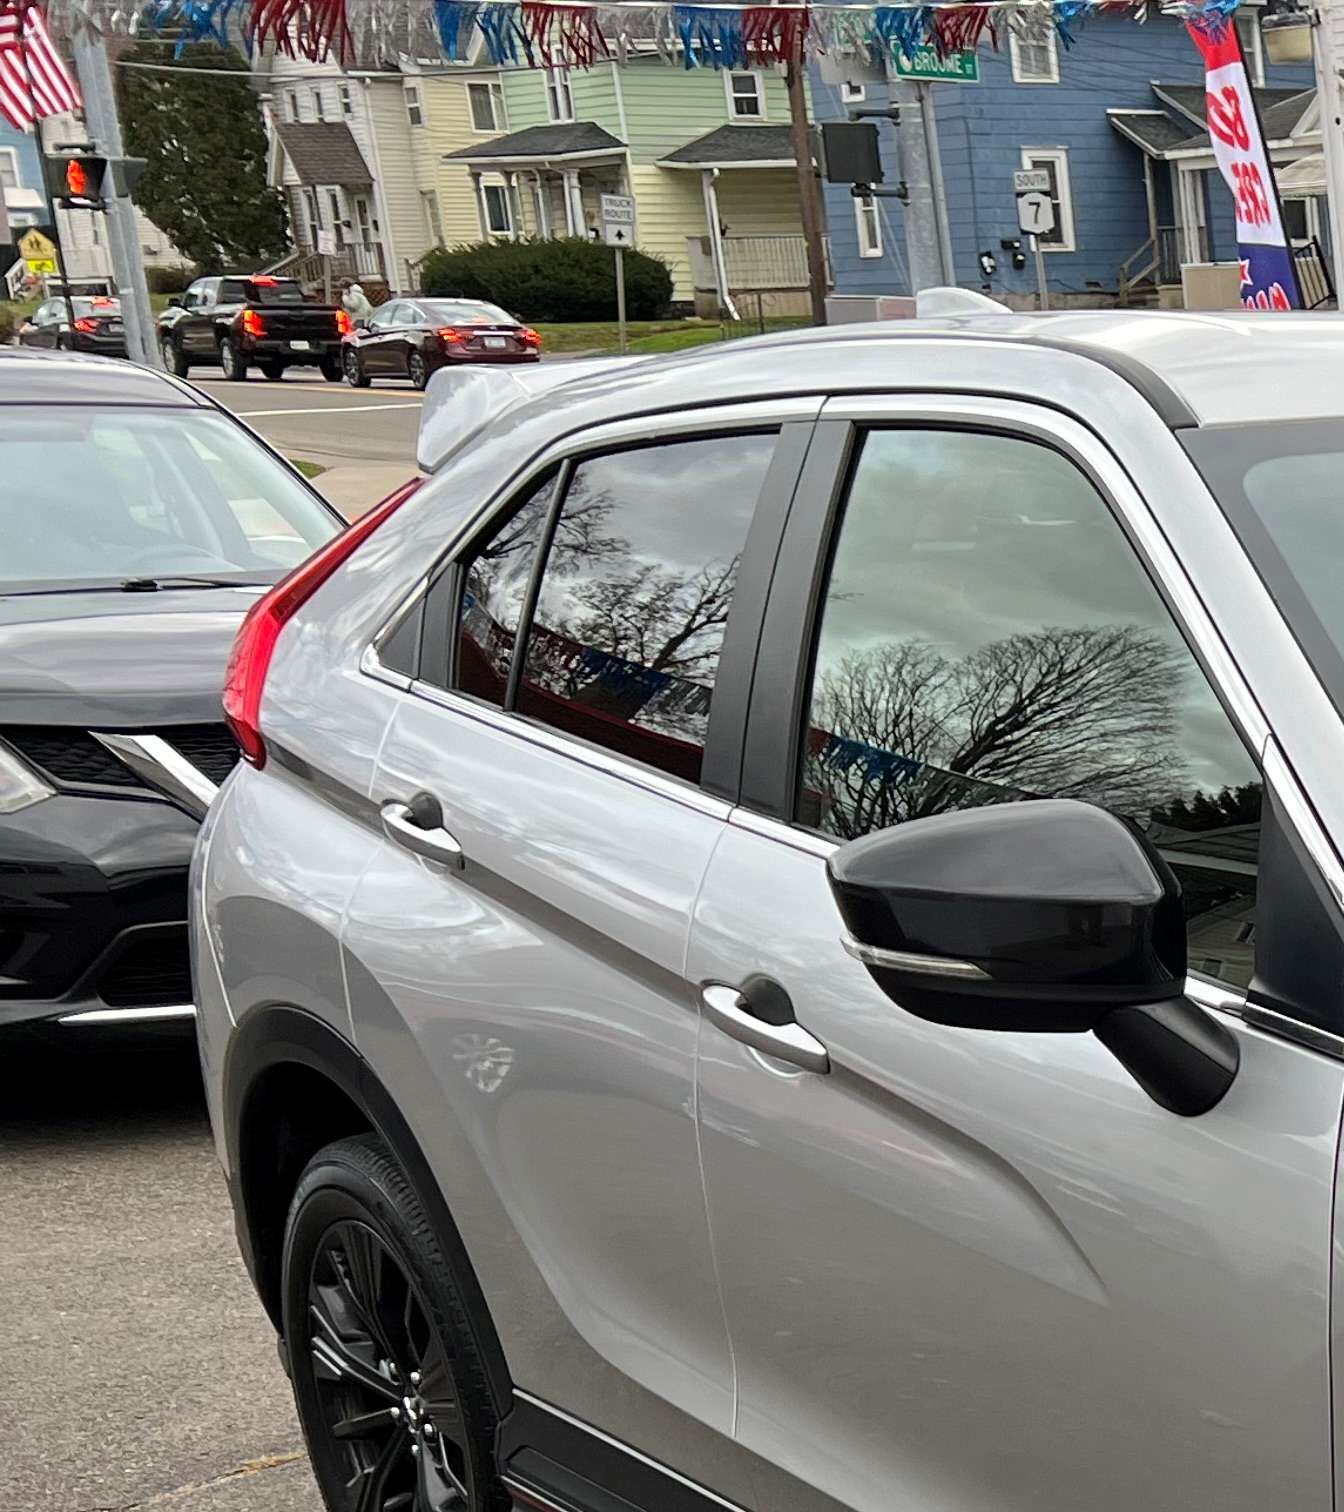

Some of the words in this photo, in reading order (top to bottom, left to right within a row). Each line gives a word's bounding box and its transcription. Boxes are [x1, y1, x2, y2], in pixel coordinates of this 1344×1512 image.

[1016, 174, 1047, 187] SOUTH
[605, 198, 632, 208] TRUCK
[605, 209, 632, 220] ROUTE
[1028, 201, 1041, 225] 7
